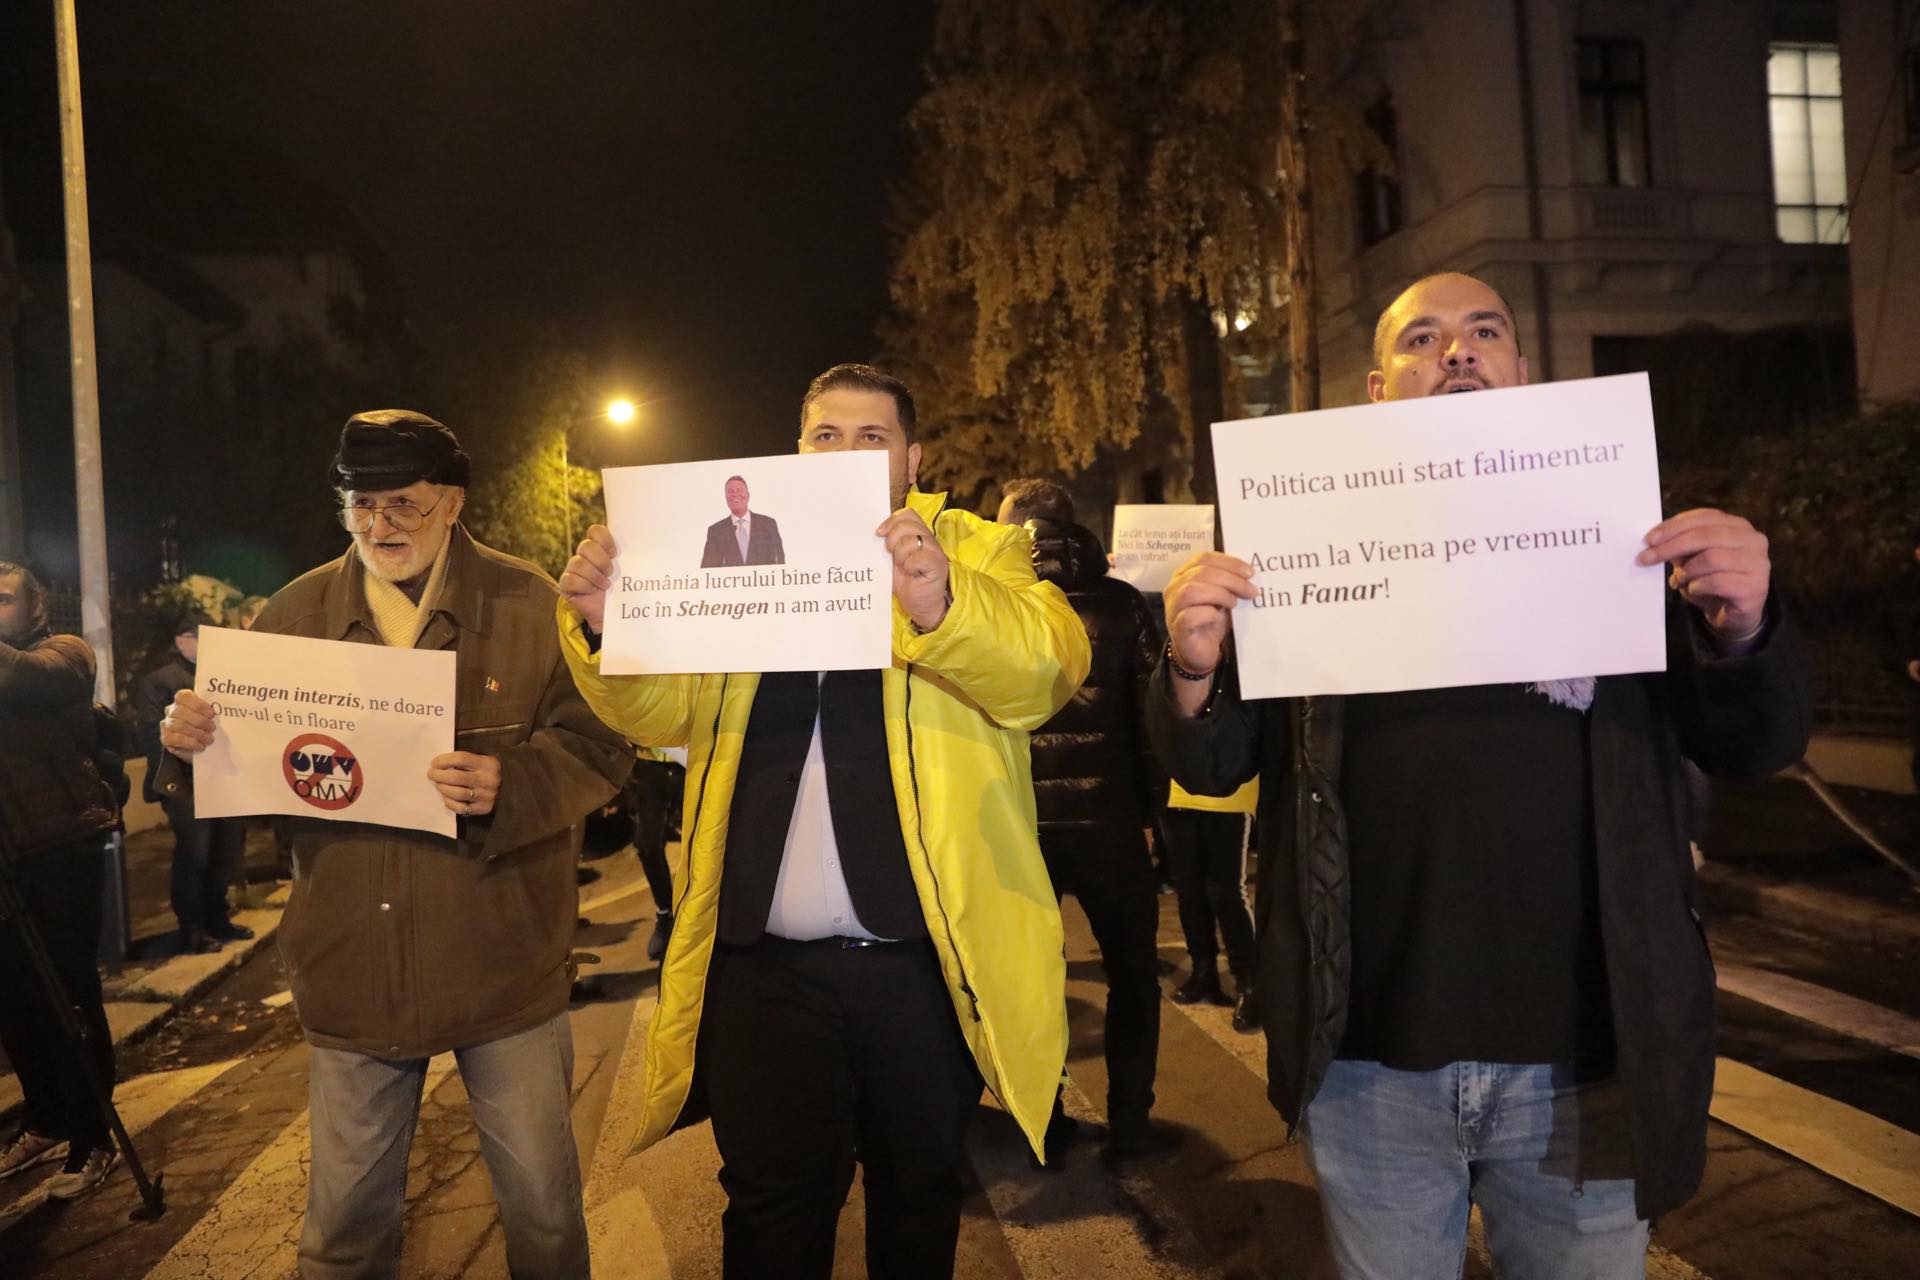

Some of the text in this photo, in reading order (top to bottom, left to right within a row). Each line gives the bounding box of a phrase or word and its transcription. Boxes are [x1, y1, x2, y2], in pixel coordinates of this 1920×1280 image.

[1240, 440, 1624, 500] Politica unui stat falimentar
[1146, 541, 1191, 552] Schengen
[1249, 522, 1602, 574] Acum la Viena pe vremuri
[622, 566, 873, 592] România lucrului bine făcut
[1251, 577, 1391, 609] din Fanar!
[621, 594, 872, 619] Loc în Schengen n am avut!
[208, 677, 444, 716] Schengen interzis, ne doare
[211, 701, 355, 731] Omv-ul e în floare
[293, 779, 358, 803] OMV
